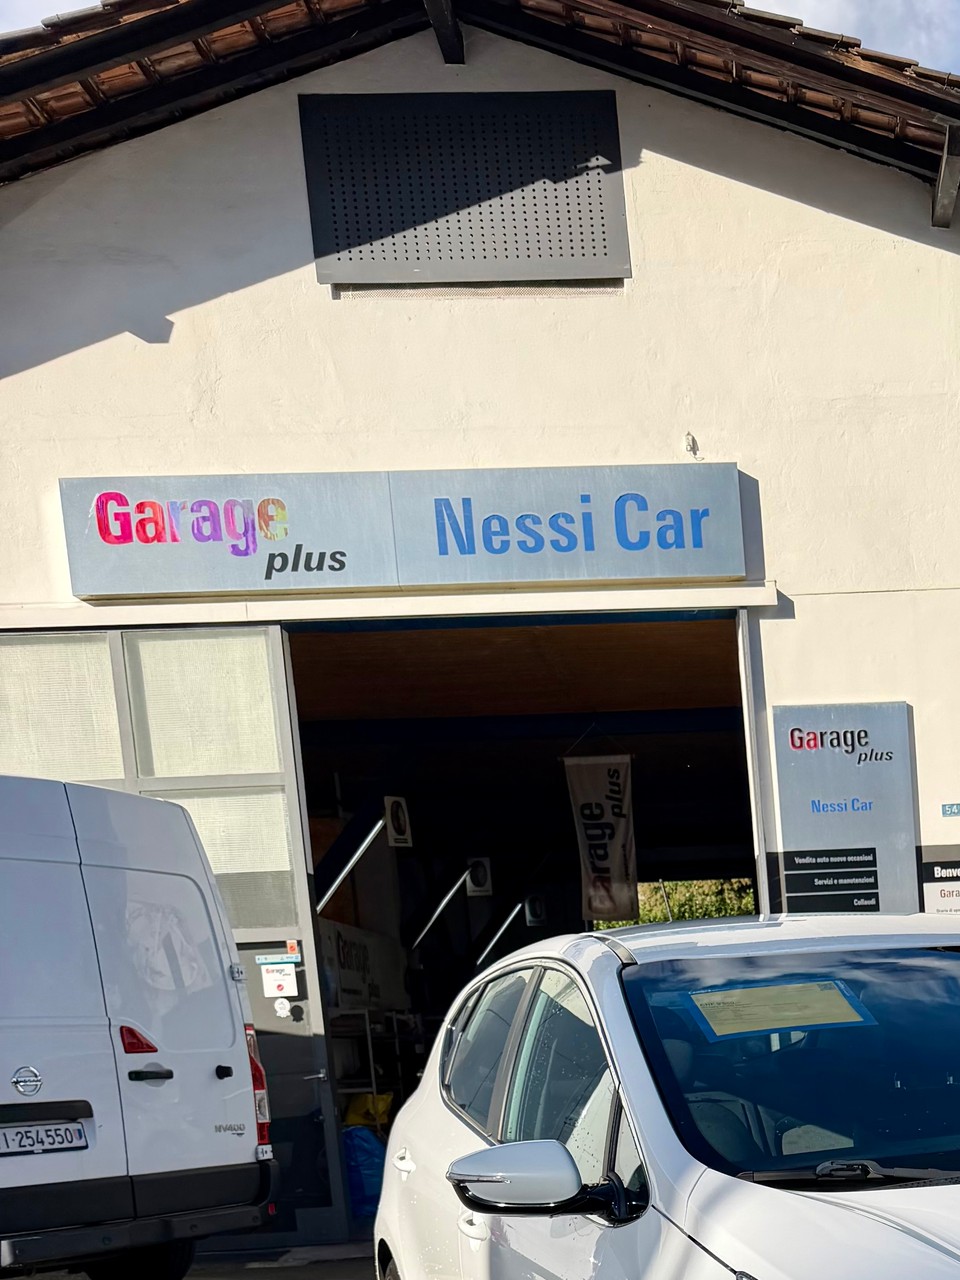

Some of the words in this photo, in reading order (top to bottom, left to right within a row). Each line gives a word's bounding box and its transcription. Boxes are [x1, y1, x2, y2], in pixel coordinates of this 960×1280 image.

[95, 491, 289, 557] Garage
[434, 494, 596, 556] Nessi
[614, 492, 710, 551] Car
[264, 543, 347, 580] plus
[790, 727, 869, 754] Garage
[857, 748, 893, 765] plus
[605, 768, 627, 819] plus
[811, 799, 848, 814] Nessi
[851, 798, 874, 812] Car
[945, 805, 959, 815] 54
[794, 856, 816, 864] Vendita
[847, 854, 873, 862] occasioni
[814, 877, 833, 886] Servizi
[838, 876, 875, 884] manutenzioni
[853, 898, 876, 906] Collaudi
